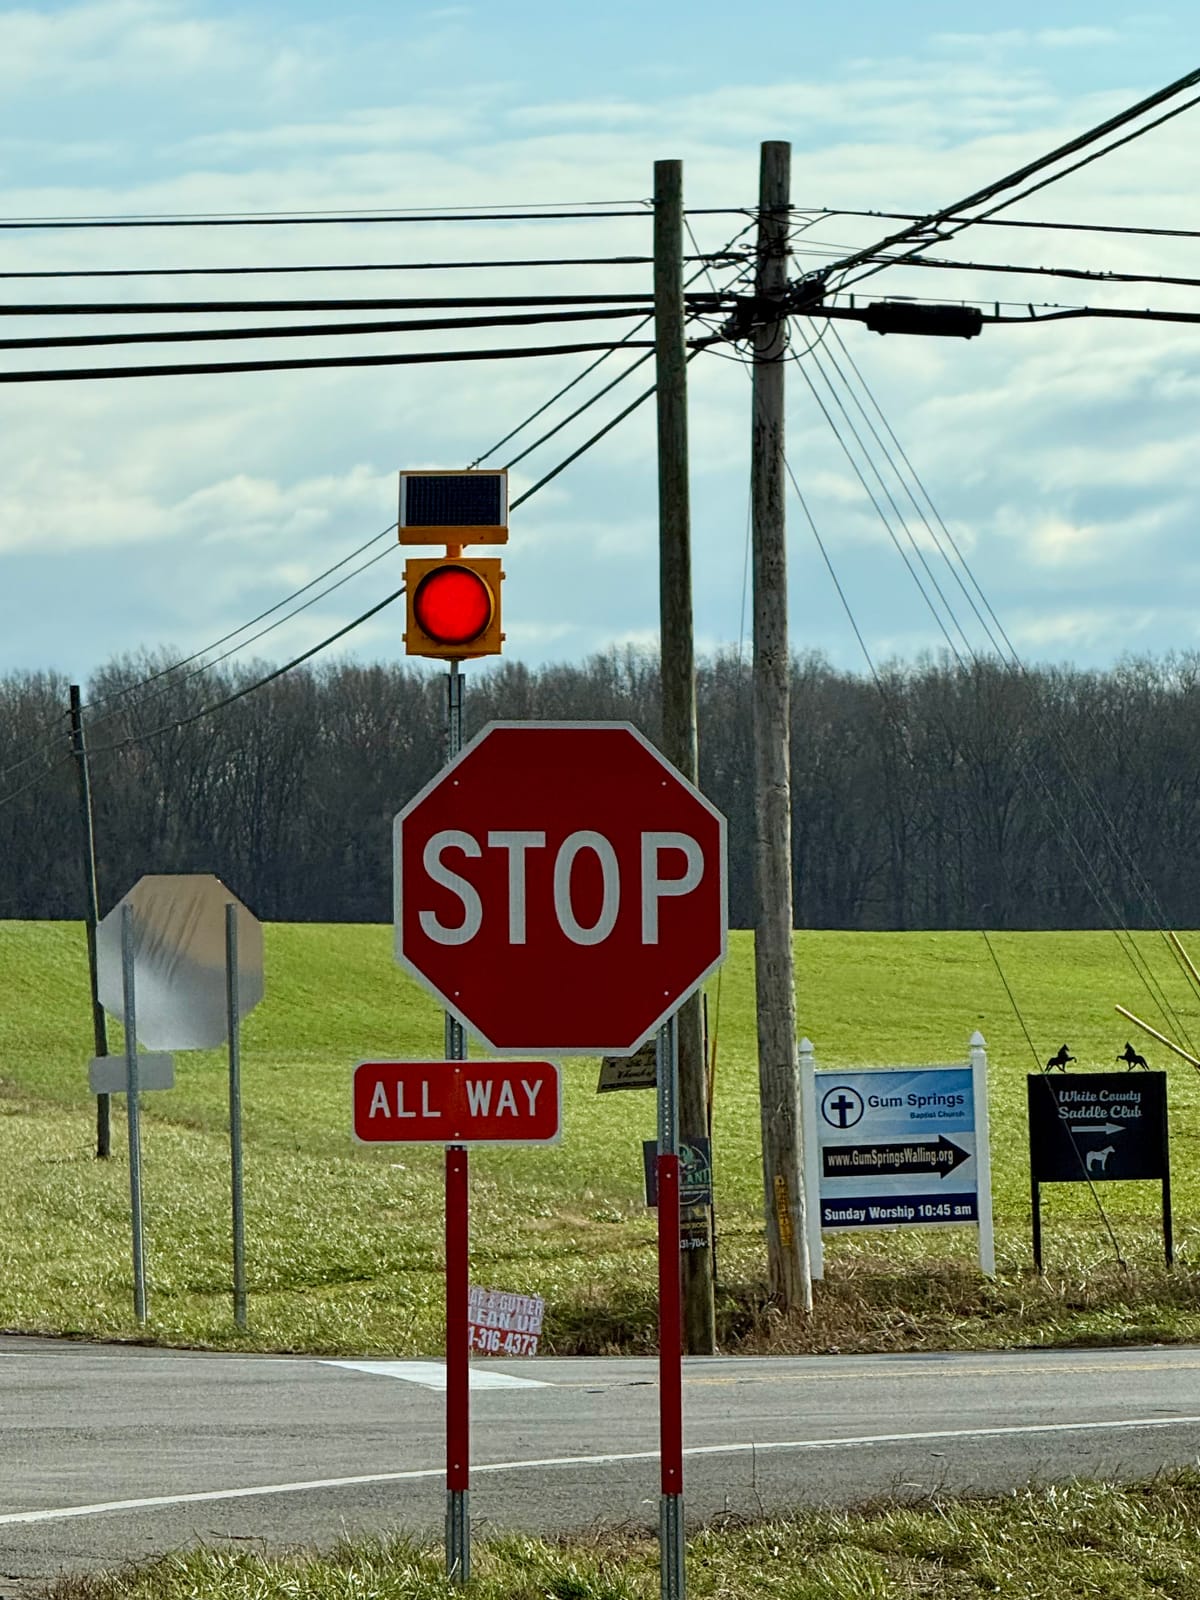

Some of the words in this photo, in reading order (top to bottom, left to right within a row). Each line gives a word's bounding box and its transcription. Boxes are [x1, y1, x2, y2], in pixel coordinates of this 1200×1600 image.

[418, 829, 705, 946] STOP
[368, 1080, 442, 1119] ALL
[465, 1079, 544, 1118] WAY
[868, 1095, 903, 1108] Gum
[907, 1092, 965, 1108] Springs
[1059, 1090, 1098, 1103] White
[1099, 1089, 1142, 1104] County
[938, 1110, 966, 1118] Church
[1058, 1105, 1109, 1120] Saddle
[1110, 1104, 1143, 1119] Club
[828, 1147, 954, 1168] www.GumSpringsWalling.org
[825, 1207, 866, 1222] Sunday
[869, 1204, 916, 1220] Worship
[918, 1203, 951, 1218] 10:45
[954, 1205, 972, 1216] am
[500, 1295, 543, 1316] GUTTER
[468, 1305, 511, 1330] LEAN
[517, 1314, 541, 1334] UP
[468, 1325, 538, 1356] 1-316-4373
